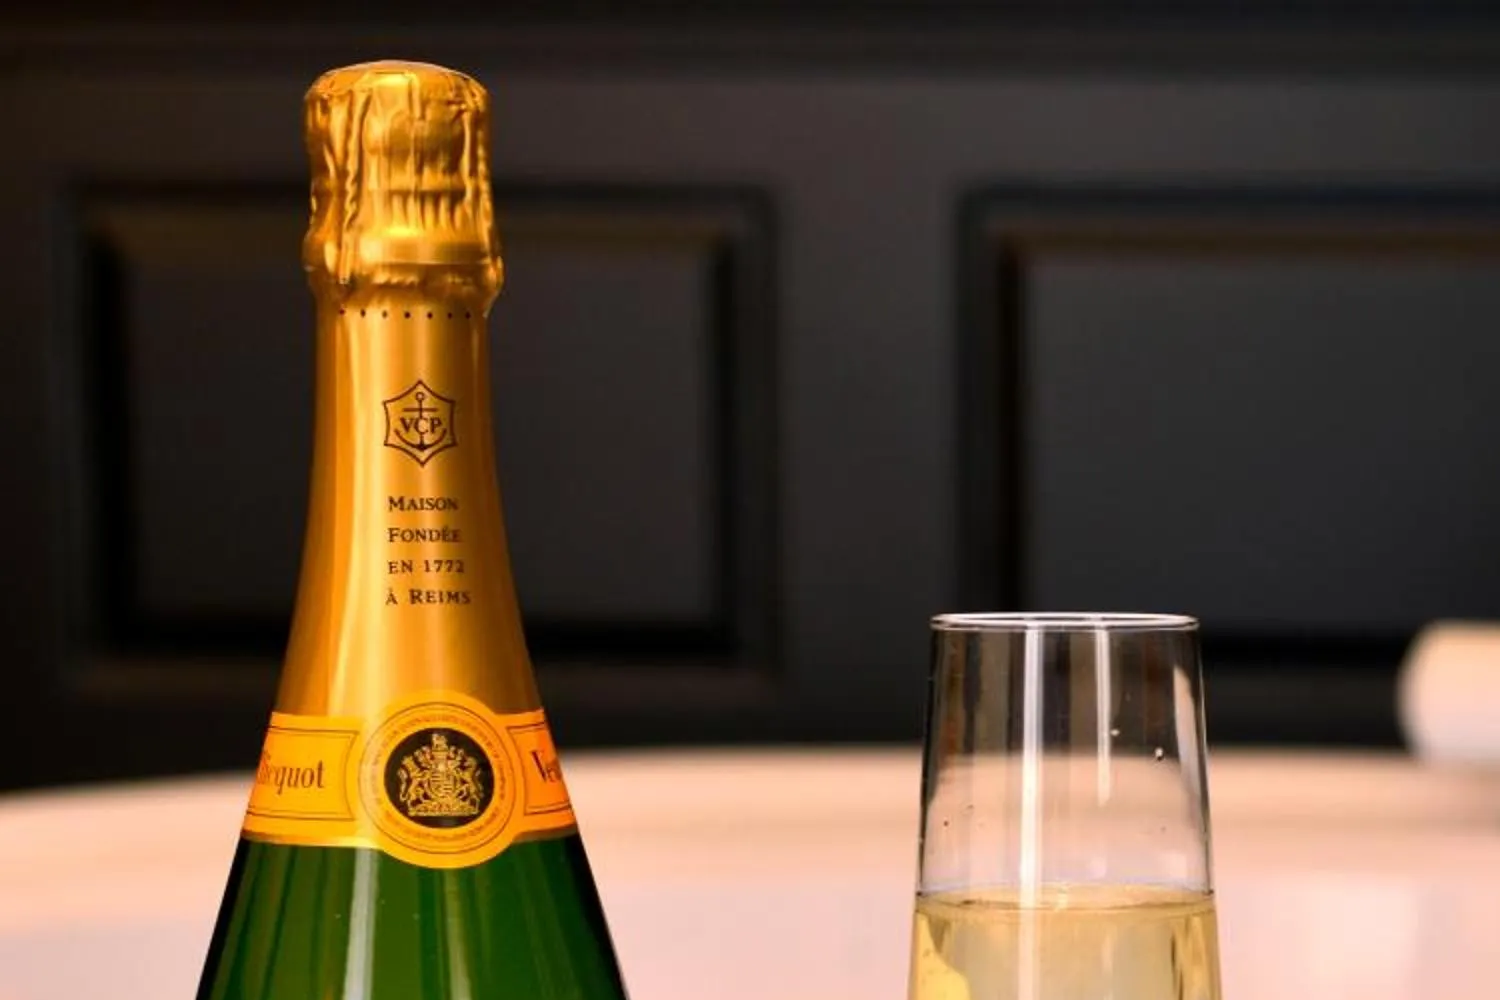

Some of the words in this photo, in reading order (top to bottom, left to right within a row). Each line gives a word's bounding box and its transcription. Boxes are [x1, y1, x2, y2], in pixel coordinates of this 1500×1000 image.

[399, 417, 443, 435] VCP
[388, 560, 414, 575] EN
[424, 559, 465, 574] 1772
[408, 588, 472, 605] REIMS
